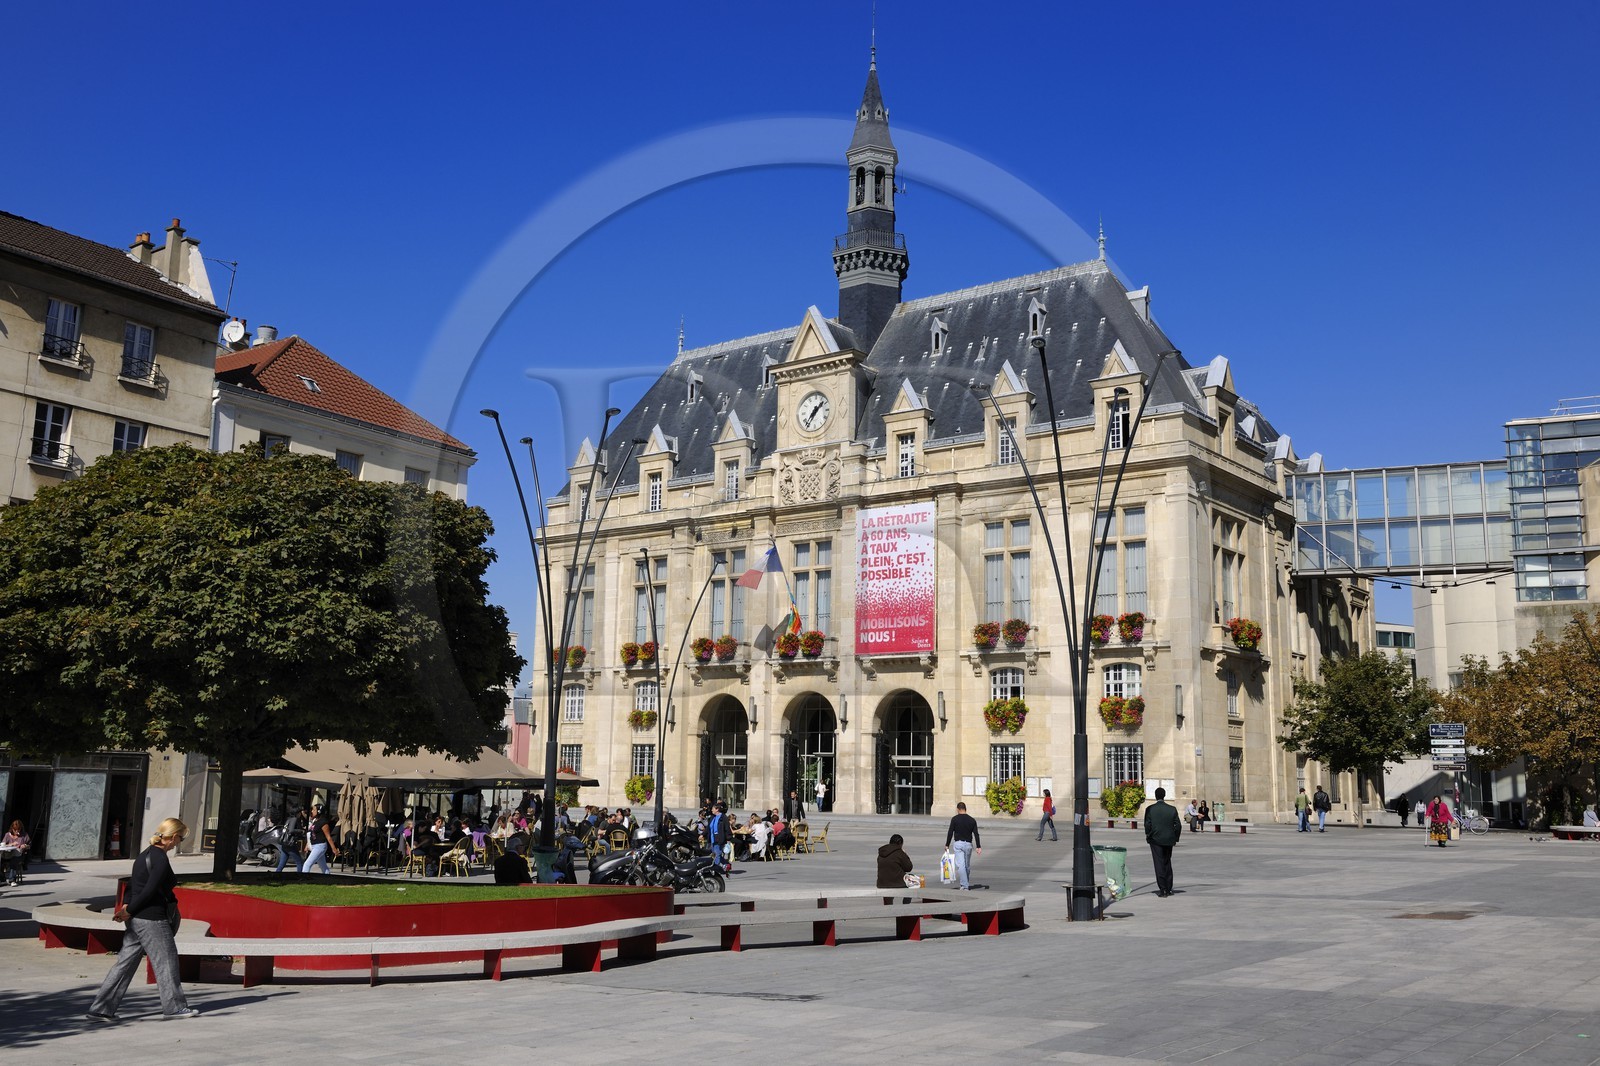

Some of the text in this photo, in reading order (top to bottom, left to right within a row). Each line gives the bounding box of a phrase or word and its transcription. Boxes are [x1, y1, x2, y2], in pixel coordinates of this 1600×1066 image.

[862, 512, 928, 529] LA RETRAITE
[861, 528, 911, 542] À 60 ANS,
[861, 542, 898, 555] À TAUX
[861, 552, 926, 568] PLEIN, C'EST
[861, 567, 911, 581] POSSIBLE
